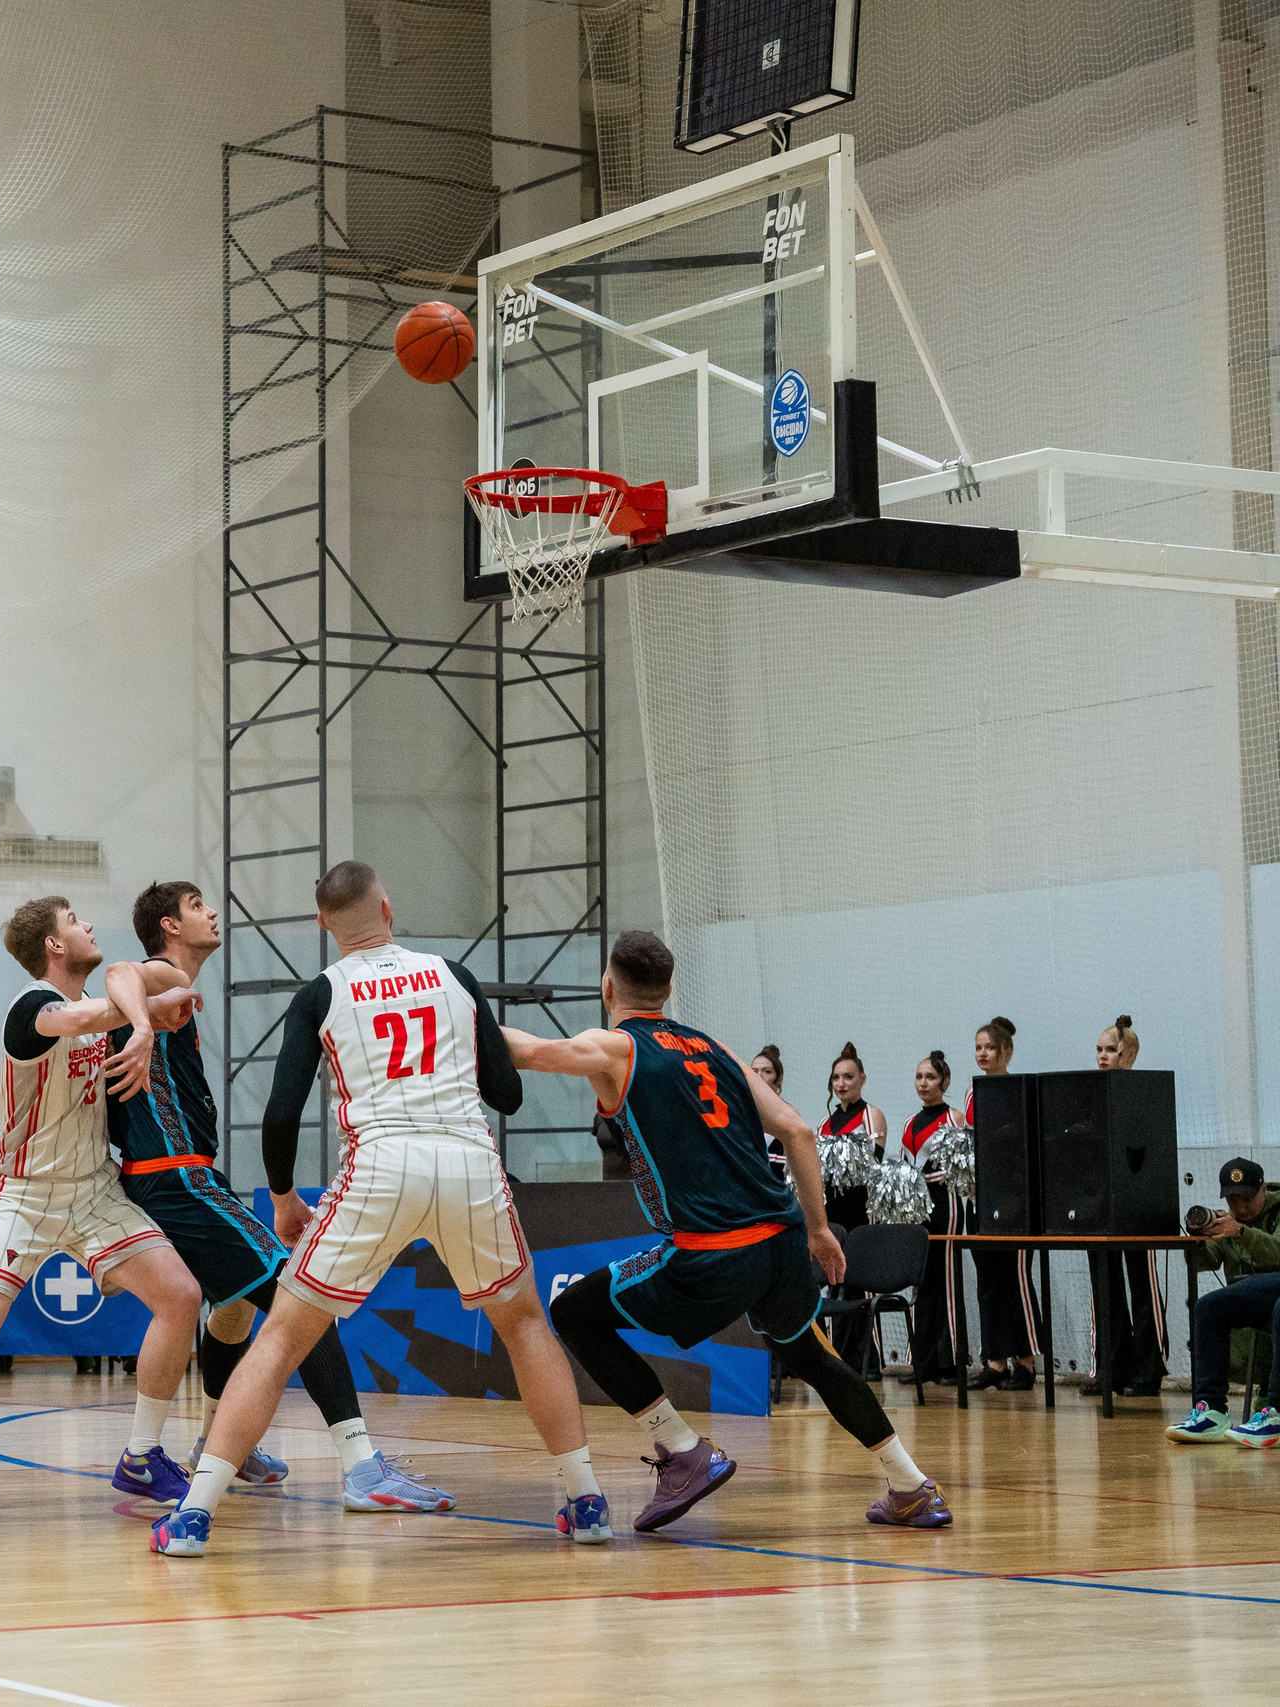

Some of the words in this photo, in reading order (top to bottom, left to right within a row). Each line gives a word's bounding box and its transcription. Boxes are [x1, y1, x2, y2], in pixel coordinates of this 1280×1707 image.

[762, 200, 807, 236] FON
[762, 229, 807, 264] BET
[503, 292, 538, 324] FON
[503, 315, 539, 348] BET
[775, 421, 804, 439] ВЫСШАЯ
[350, 969, 442, 1003] КУДРИН
[372, 1005, 437, 1080] 27
[683, 1060, 730, 1129] 3
